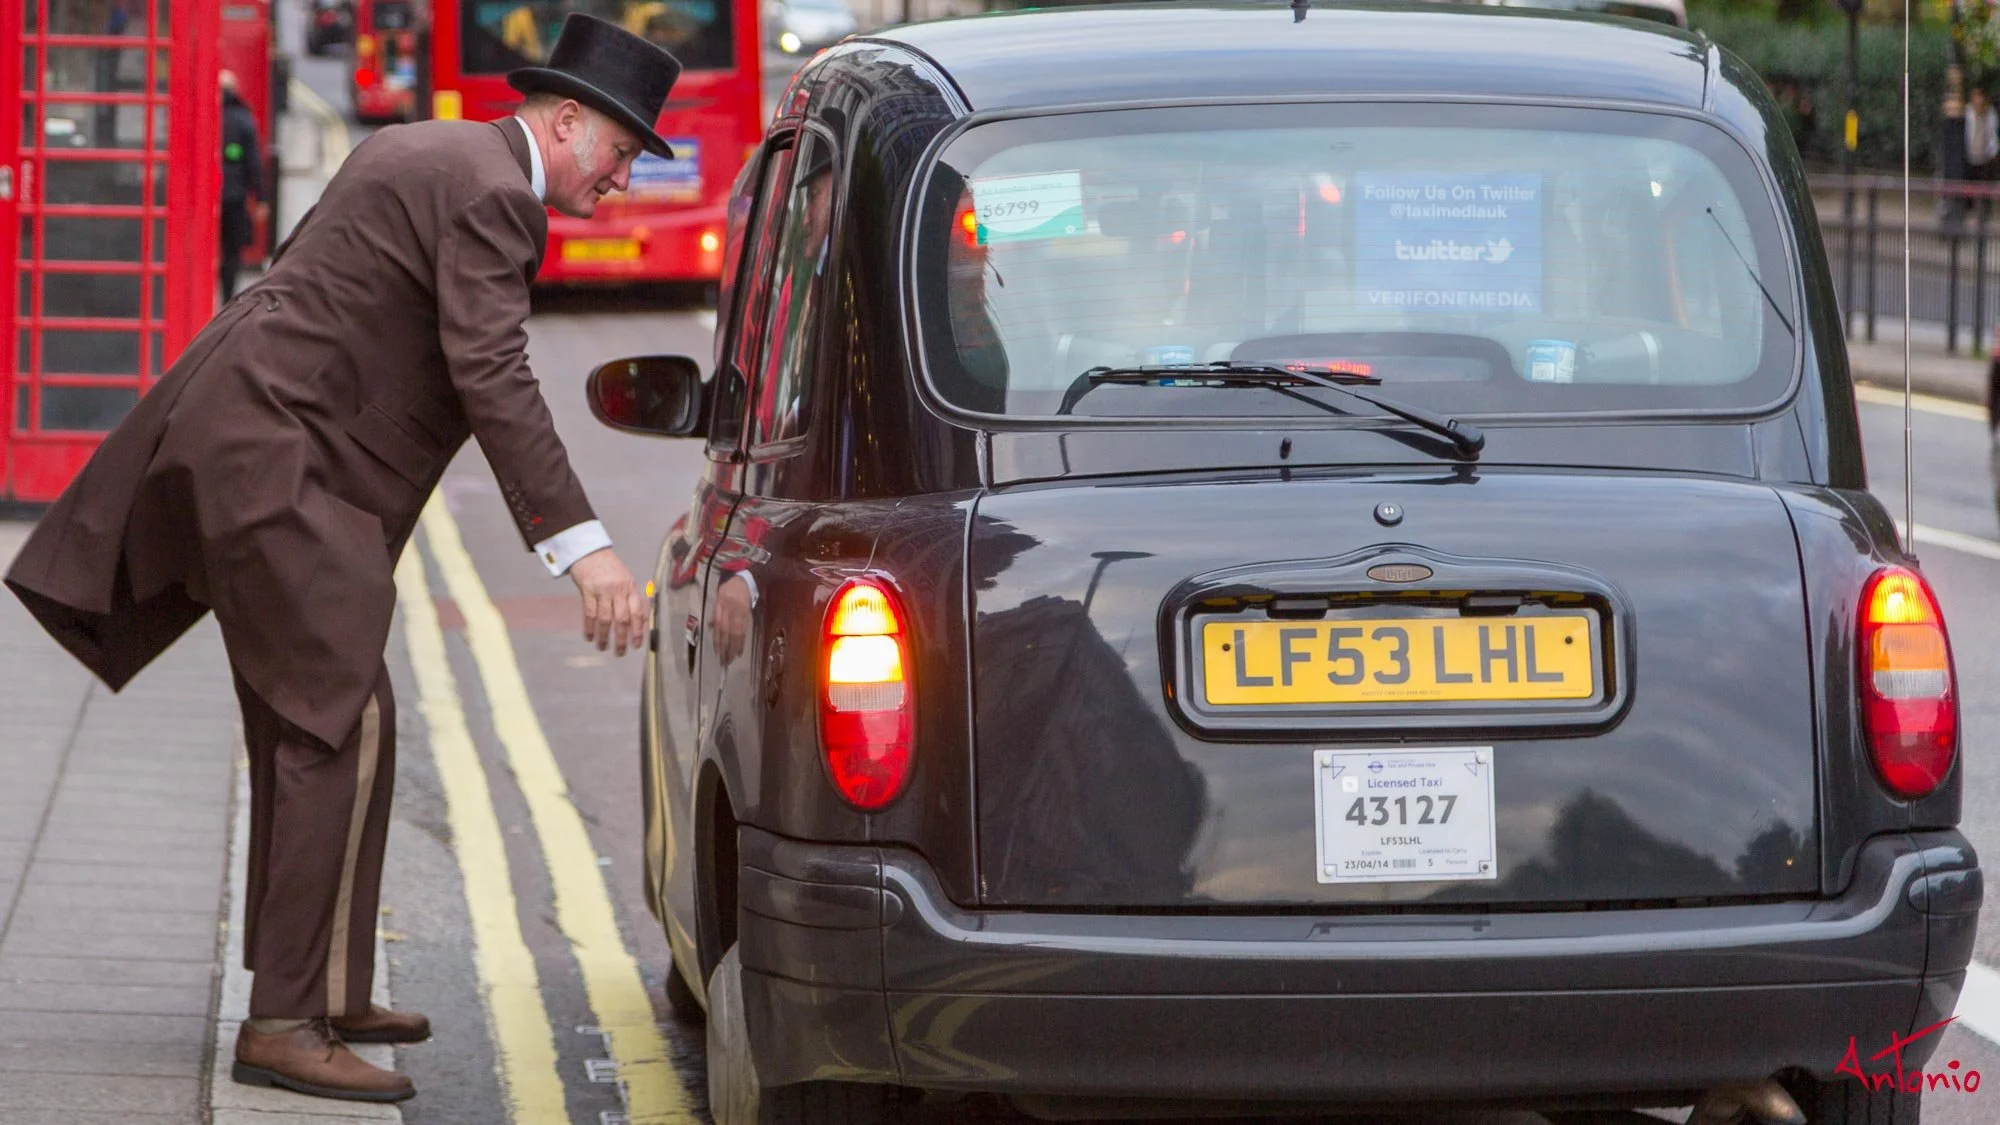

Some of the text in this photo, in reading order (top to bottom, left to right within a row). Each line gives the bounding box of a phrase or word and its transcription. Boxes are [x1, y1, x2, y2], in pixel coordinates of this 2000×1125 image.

[1364, 184, 1536, 201] Follow Us On Twitter
[983, 200, 1039, 218] 56799
[1390, 203, 1507, 219] @taximediauk
[1395, 239, 1486, 261] twitter
[1233, 625, 1564, 688] LF53 LHL
[1367, 777, 1442, 789] Licensed Taxi
[1345, 795, 1458, 826] 43127
[1381, 836, 1422, 846] LF53LHL
[1344, 859, 1389, 870] 23/04/14
[1427, 858, 1434, 868] 5
